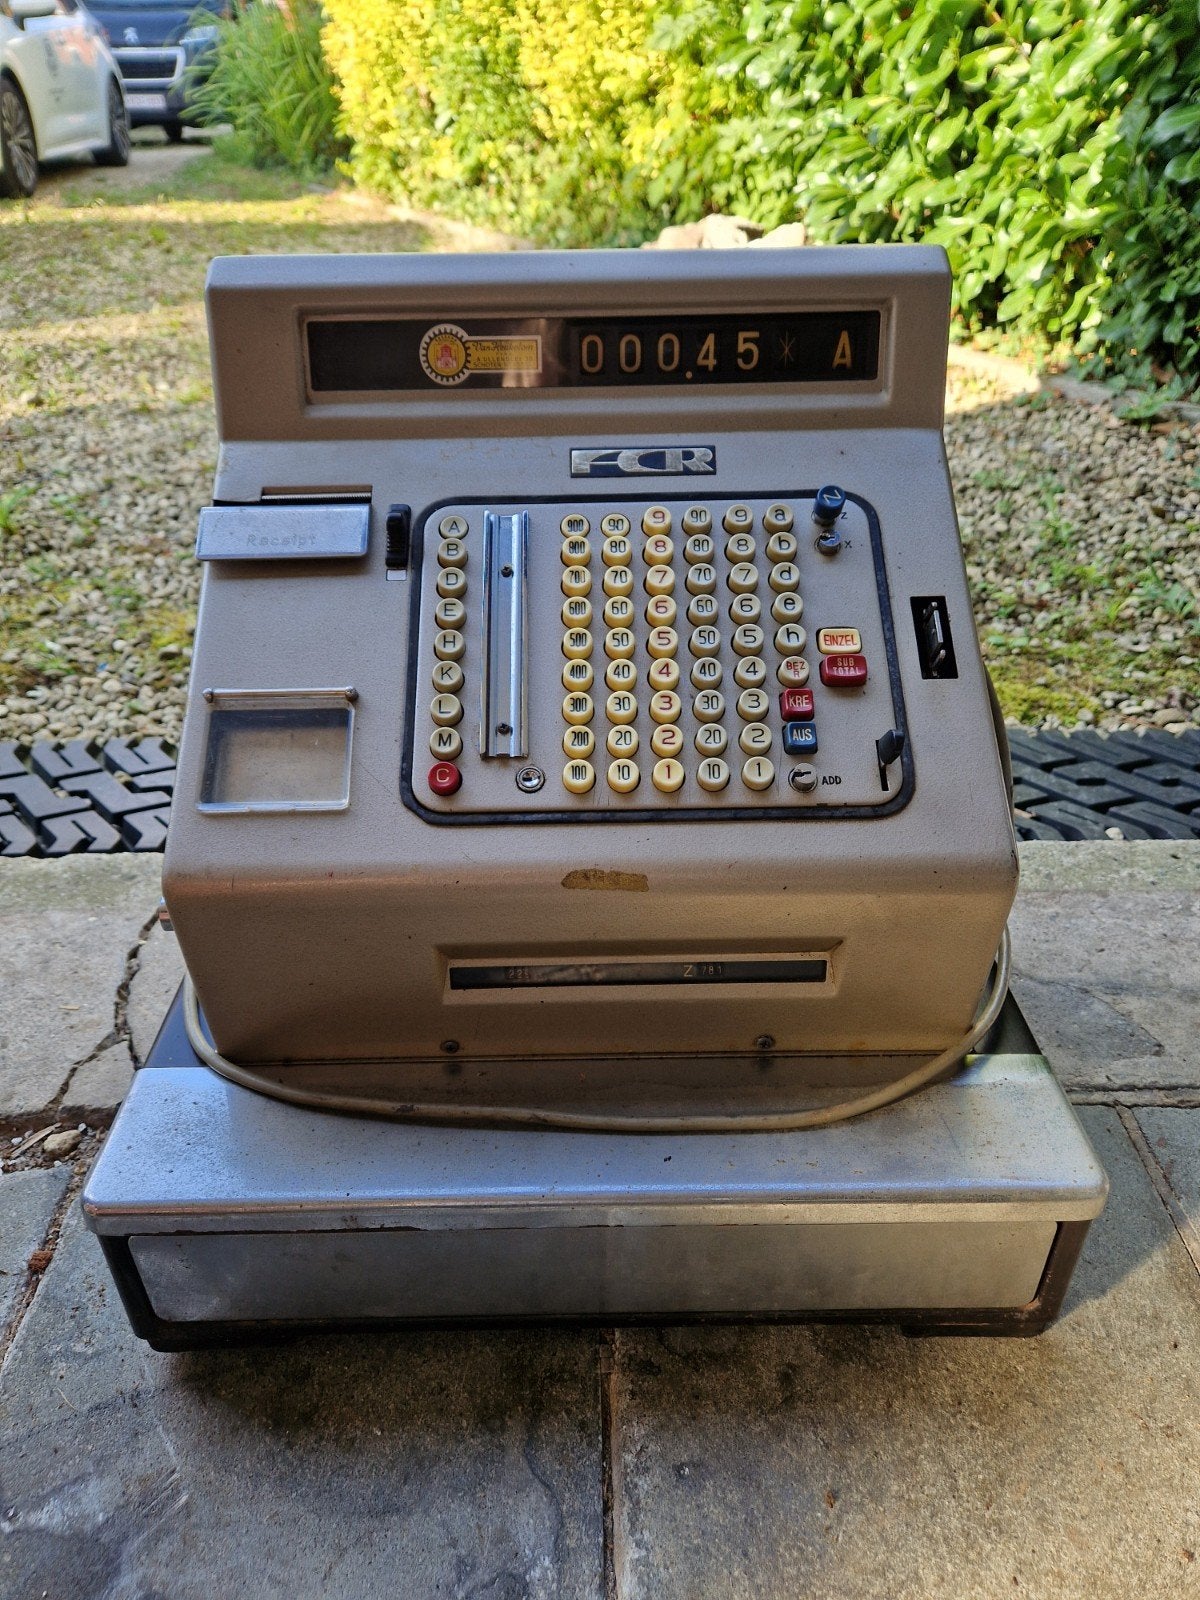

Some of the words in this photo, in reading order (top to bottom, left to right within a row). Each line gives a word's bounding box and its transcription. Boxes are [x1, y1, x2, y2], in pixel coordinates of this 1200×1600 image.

[832, 330, 852, 370] A
[652, 511, 665, 523] 9
[691, 510, 707, 523] 90
[735, 509, 747, 522] 9
[774, 508, 786, 521] a
[448, 521, 460, 532] A
[567, 520, 584, 532] 900
[608, 519, 624, 531] 90
[246, 533, 317, 548] Receipt
[610, 540, 626, 553] 80
[654, 540, 666, 552] 8
[693, 539, 709, 552] 80
[736, 539, 749, 552] 8
[778, 536, 790, 550] b
[446, 543, 459, 556] B
[446, 573, 458, 585] D
[569, 571, 586, 584] 700
[611, 570, 627, 583] 70
[655, 570, 667, 583] 7
[694, 568, 711, 581] 70
[739, 569, 751, 582] 7
[780, 566, 792, 580] d
[444, 603, 456, 616] E
[569, 602, 586, 615] 600
[611, 601, 628, 615] 60
[655, 600, 667, 614] 6
[697, 600, 713, 612] 60
[740, 598, 753, 612] 6
[784, 597, 795, 611] e
[443, 635, 456, 648] H
[569, 633, 587, 647] 500
[612, 633, 629, 647] 50
[657, 631, 671, 645] 5
[699, 630, 716, 644] 50
[743, 629, 756, 643] 5
[786, 628, 800, 643] h
[823, 634, 858, 646] EINZEL
[745, 662, 758, 676] 4
[786, 661, 806, 671] BEZ
[837, 657, 854, 667] SUB
[440, 667, 453, 680] K
[569, 665, 587, 679] 400
[613, 664, 630, 678] 40
[659, 663, 671, 677] 4
[700, 662, 716, 677] 40
[832, 666, 862, 675] TOTAL
[438, 700, 451, 714] L
[569, 698, 587, 712] 300
[614, 697, 630, 711] 30
[659, 695, 672, 710] 3
[702, 695, 719, 710] 30
[748, 693, 761, 708] 3
[788, 694, 810, 708] KRE
[438, 733, 451, 747] M
[571, 731, 589, 746] 200
[615, 731, 632, 746] 20
[662, 730, 676, 744] 2
[705, 729, 721, 744] 20
[751, 728, 765, 743] 2
[792, 728, 813, 741] AUS
[436, 769, 450, 782] C
[570, 765, 587, 780] 100
[617, 765, 630, 780] 10
[707, 764, 720, 779] 10
[822, 776, 842, 785] ADD
[683, 965, 693, 977] Z
